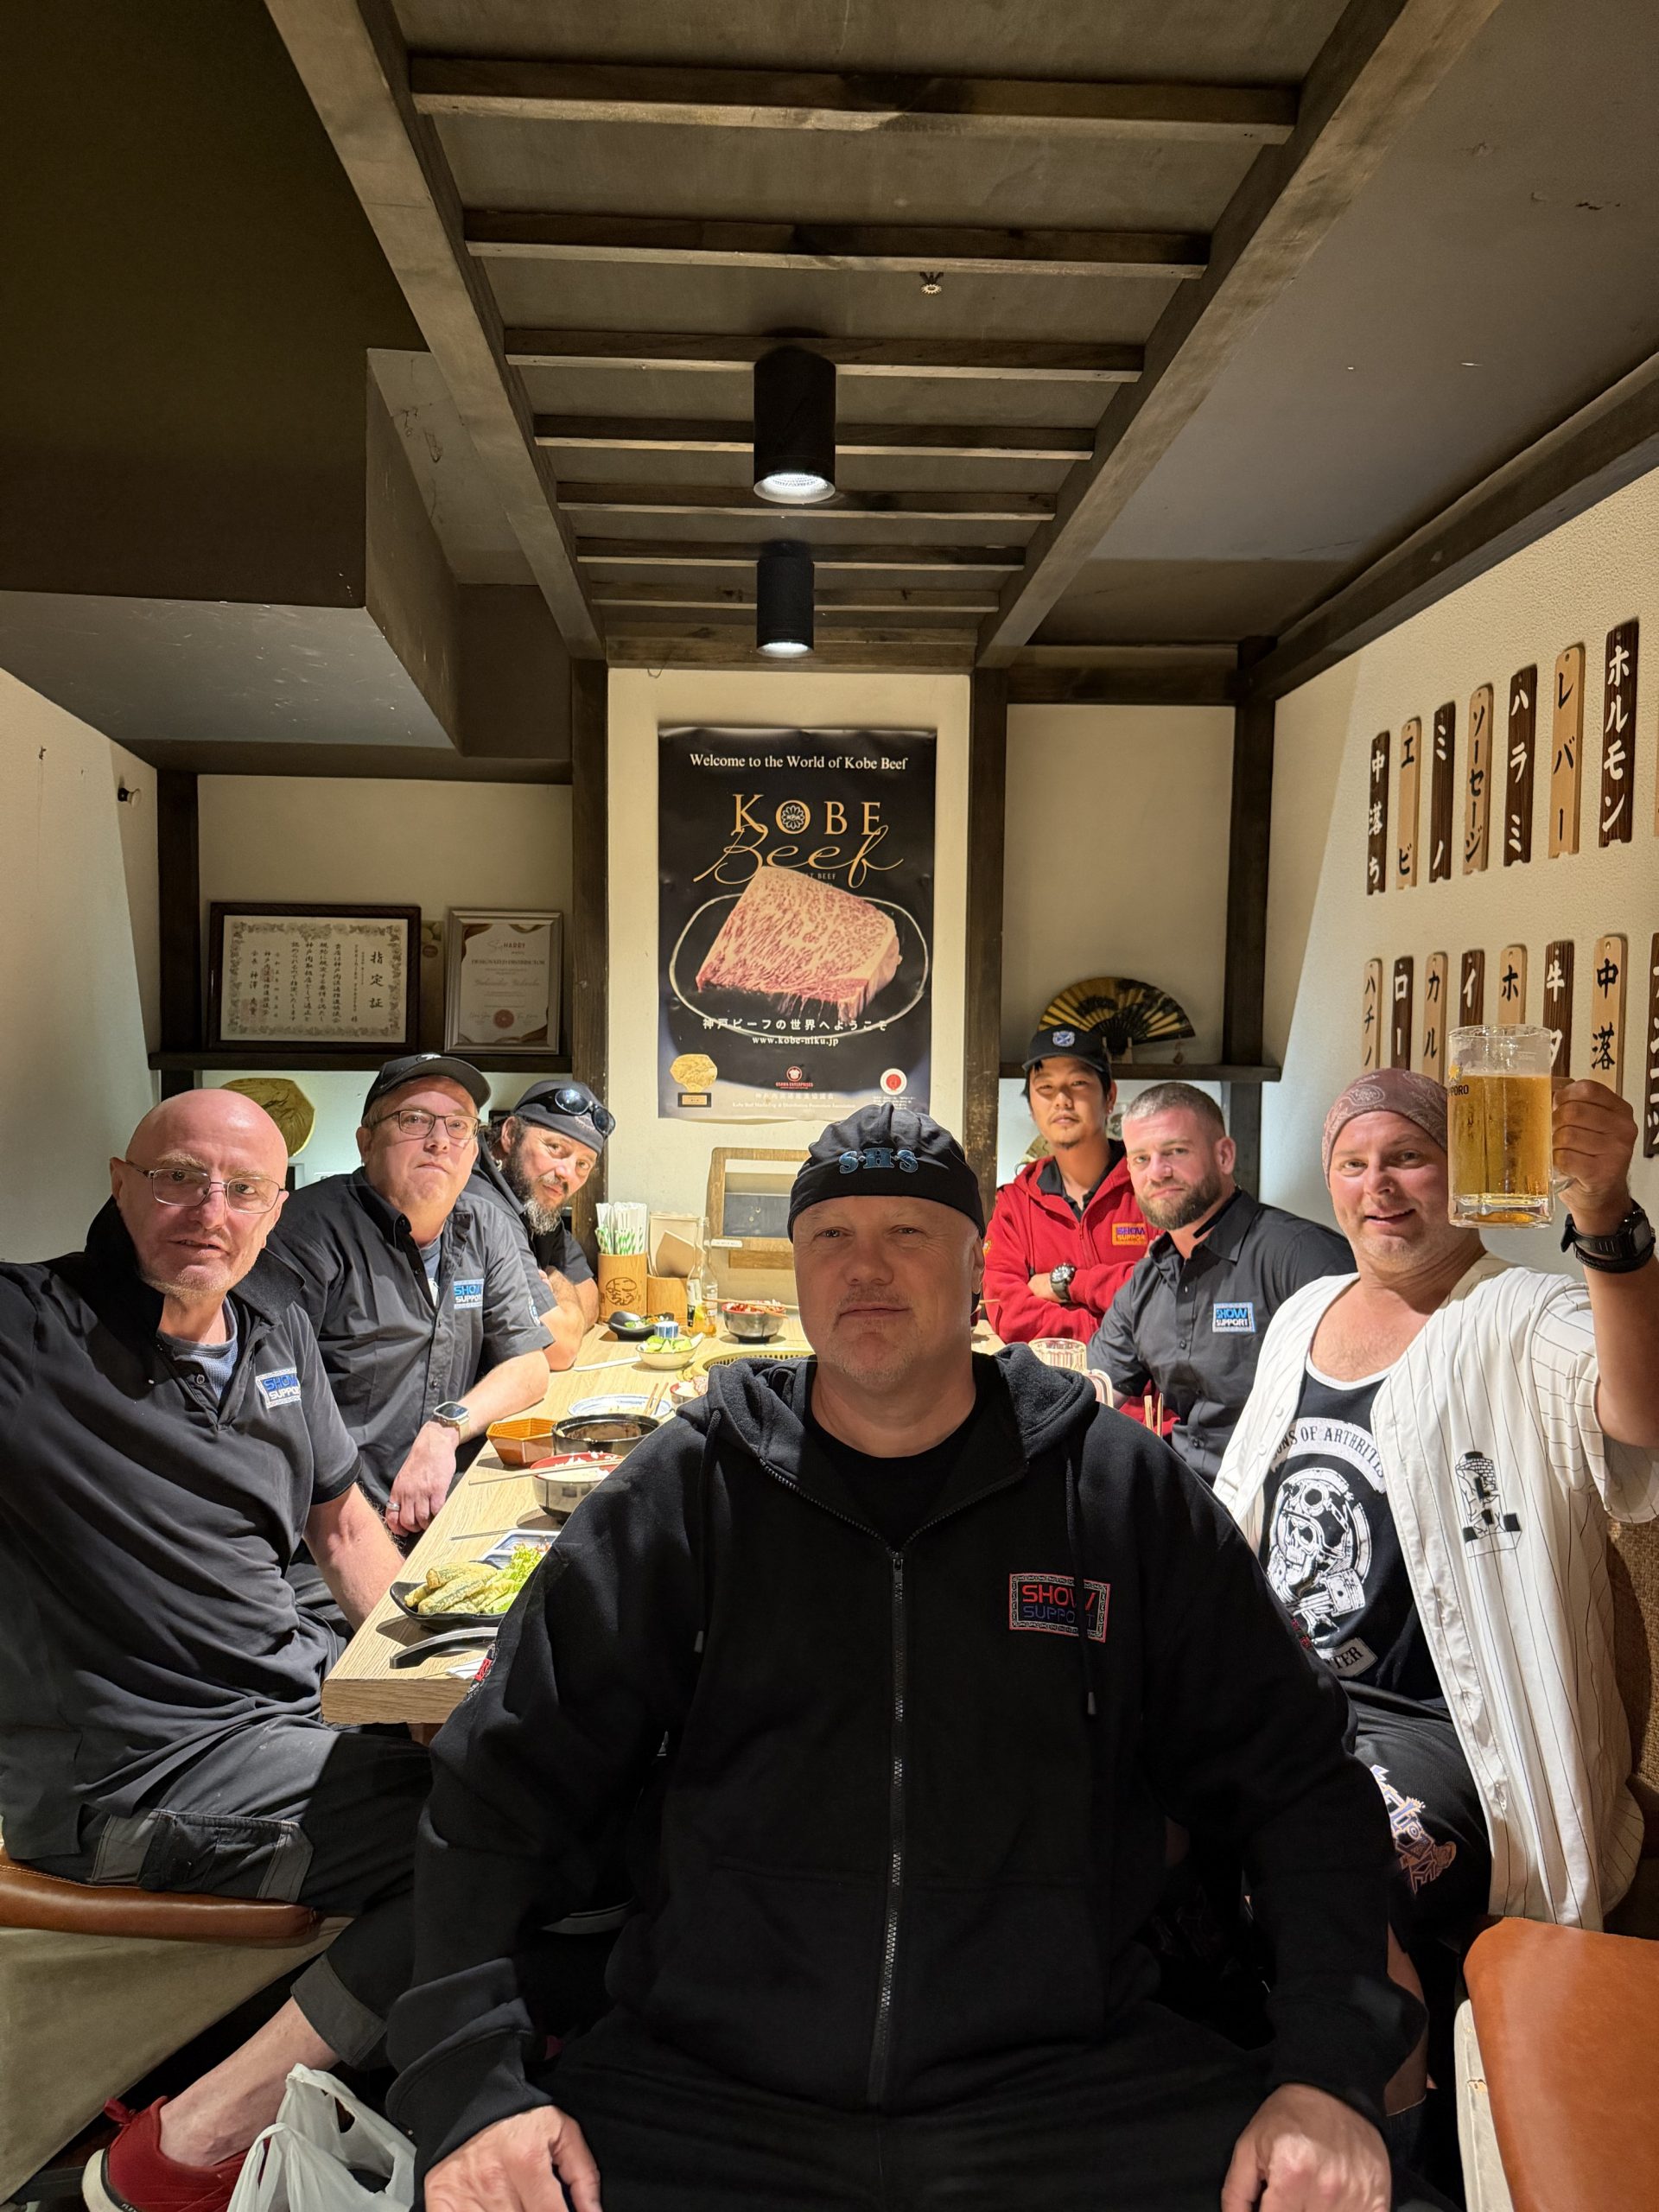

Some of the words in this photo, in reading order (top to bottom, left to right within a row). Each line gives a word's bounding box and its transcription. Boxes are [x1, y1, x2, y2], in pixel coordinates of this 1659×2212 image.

[690, 753, 745, 766] Welcome
[749, 757, 760, 767] to
[765, 755, 783, 767] the
[787, 756, 824, 768] World
[829, 757, 842, 768] of
[845, 757, 877, 769] Kobe
[881, 758, 908, 770] Beef
[1554, 671, 1574, 842] レバー
[1601, 645, 1630, 832] ホルモン
[1433, 724, 1446, 870] ミノ
[1465, 705, 1484, 862] ソーセージ
[1509, 689, 1529, 853] ハラミ
[733, 794, 881, 835] KOBE
[1369, 750, 1385, 883] 中落ち
[1399, 735, 1414, 875] エビ
[693, 823, 904, 888] Beef
[370, 951, 385, 1009] 指定証
[702, 1018, 888, 1033] 神戸ビーフの世界へようこそ
[753, 1036, 840, 1047] www.kobe-niku.jp
[1592, 958, 1618, 1070] 中落
[1216, 1307, 1248, 1319] SHOW
[1216, 1319, 1249, 1327] SUPPORT
[1300, 1426, 1318, 1442] OF
[1023, 1605, 1096, 1628] SUPPOT
